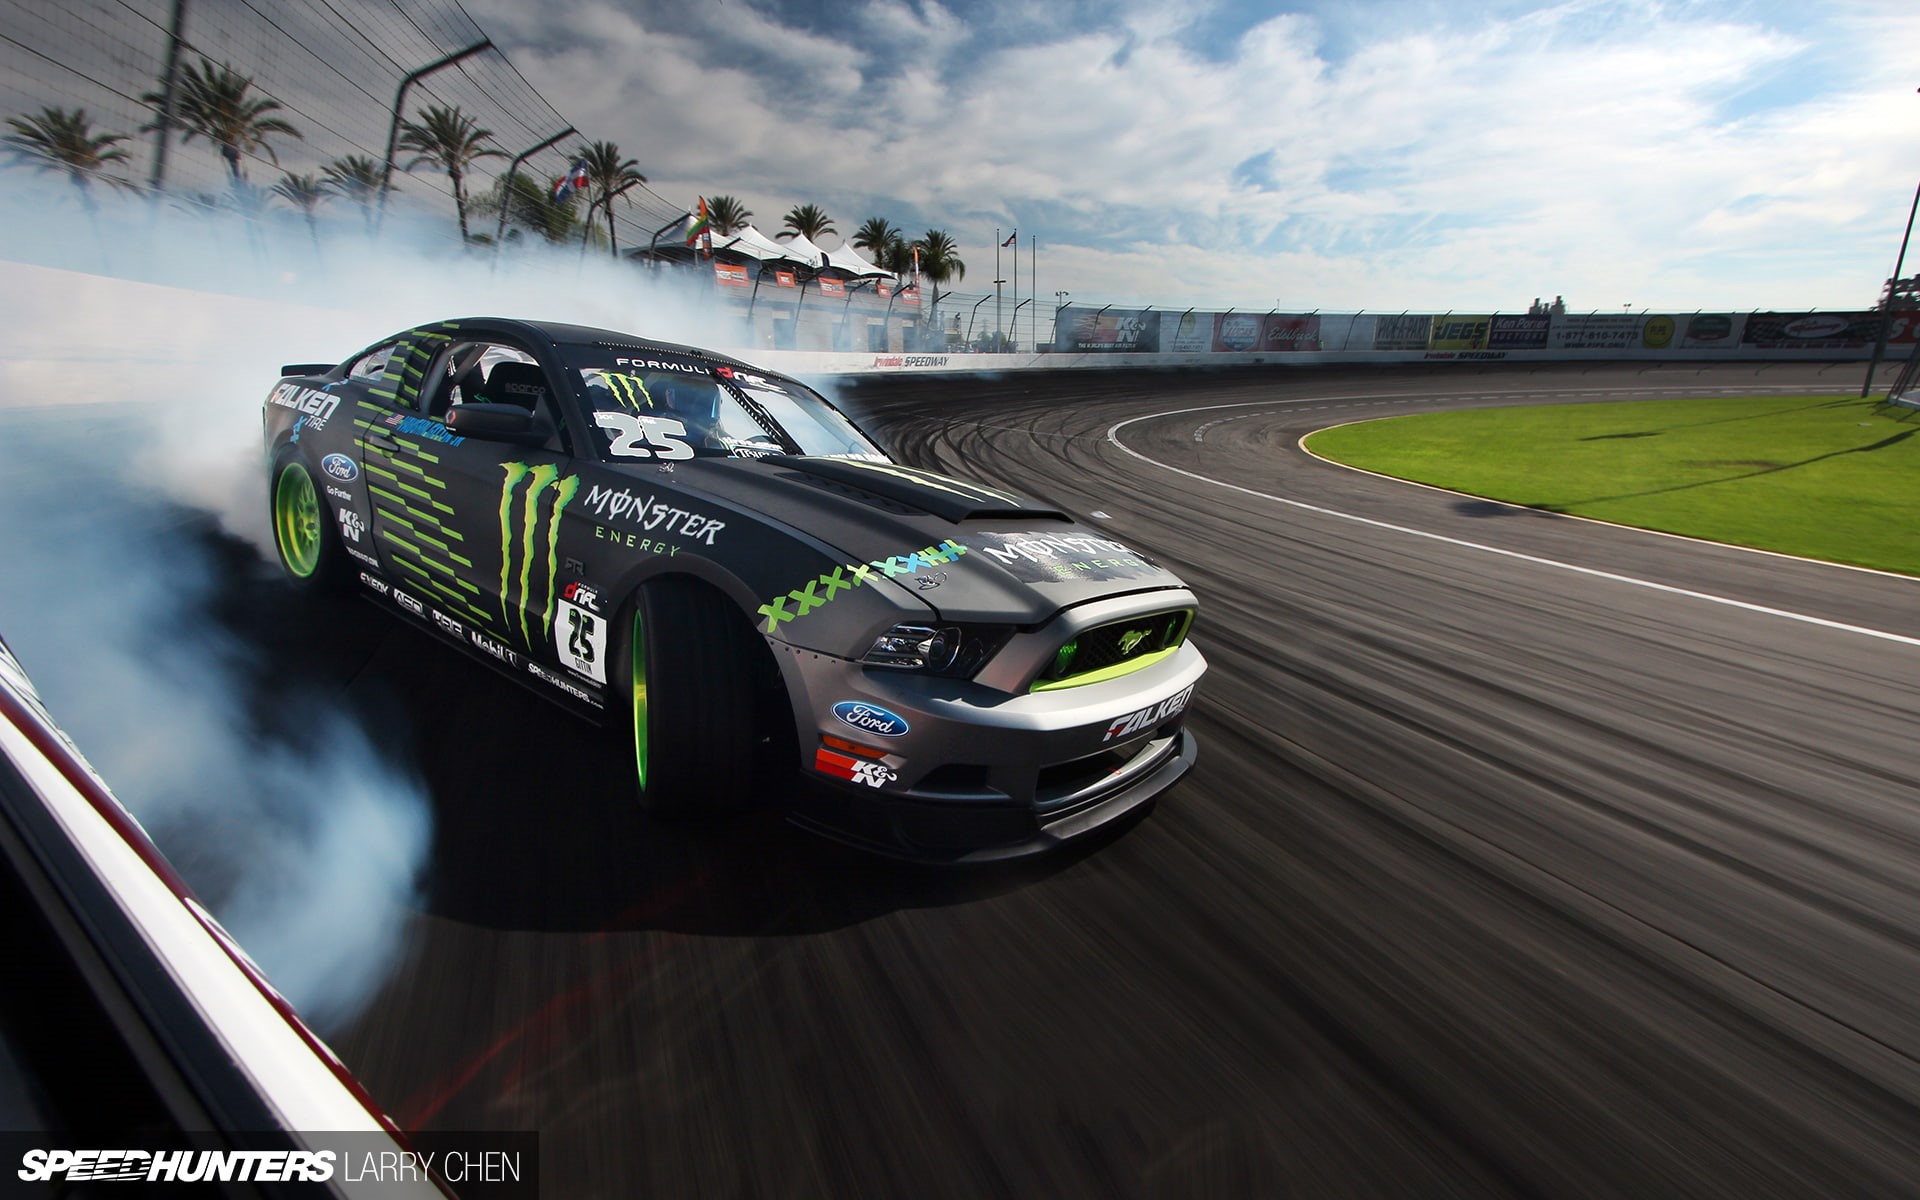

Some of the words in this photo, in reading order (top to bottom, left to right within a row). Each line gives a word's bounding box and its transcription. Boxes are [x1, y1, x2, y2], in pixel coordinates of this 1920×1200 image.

[1434, 322, 1489, 340] JEGS
[904, 357, 950, 367] SPEEDWAY
[270, 383, 342, 420] FALKEN
[305, 415, 328, 432] TIRE
[592, 411, 695, 460] 25
[595, 526, 681, 557] ENERGY
[568, 608, 596, 663] 25
[1102, 683, 1195, 742] FALKEN
